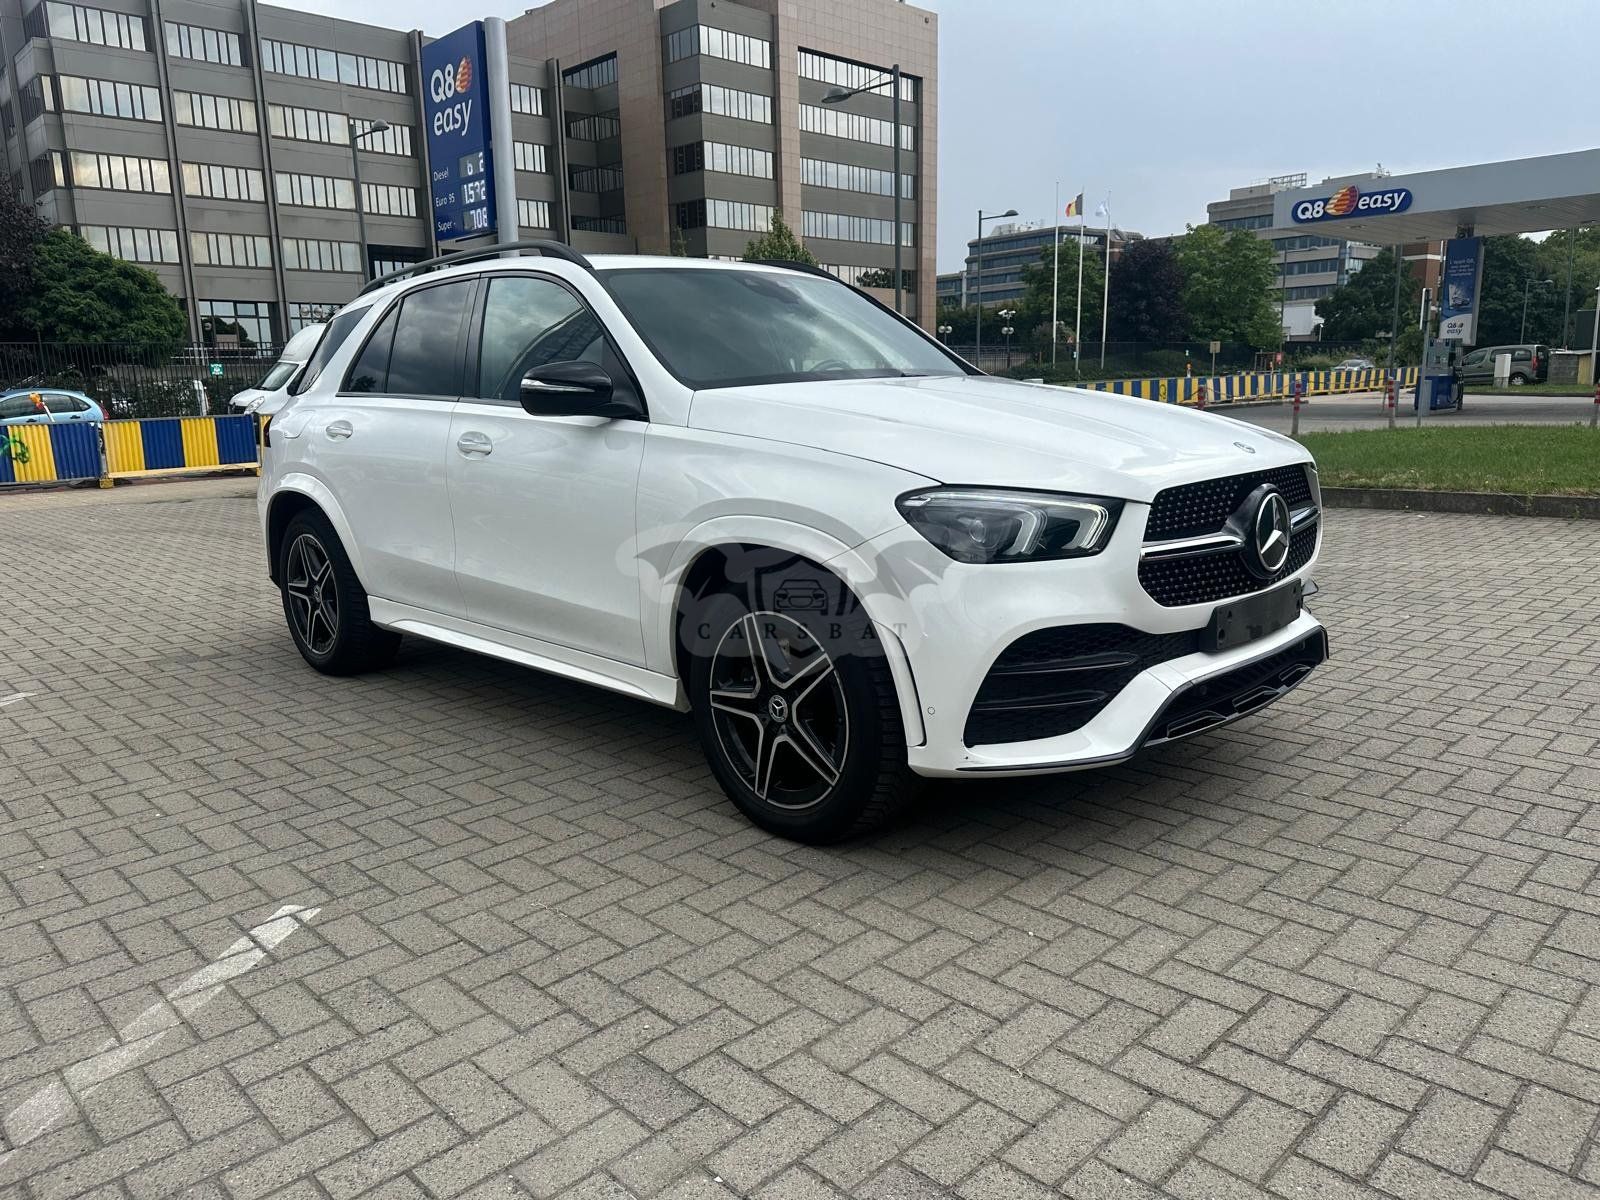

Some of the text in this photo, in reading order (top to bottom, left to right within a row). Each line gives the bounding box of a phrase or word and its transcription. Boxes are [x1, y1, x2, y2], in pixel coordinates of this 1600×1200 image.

[430, 63, 455, 103] Q8
[434, 98, 472, 136] easy
[434, 167, 449, 181] Diesel
[435, 197, 448, 207] Euro
[1297, 192, 1406, 220] Q8 easy
[437, 222, 453, 232] Super
